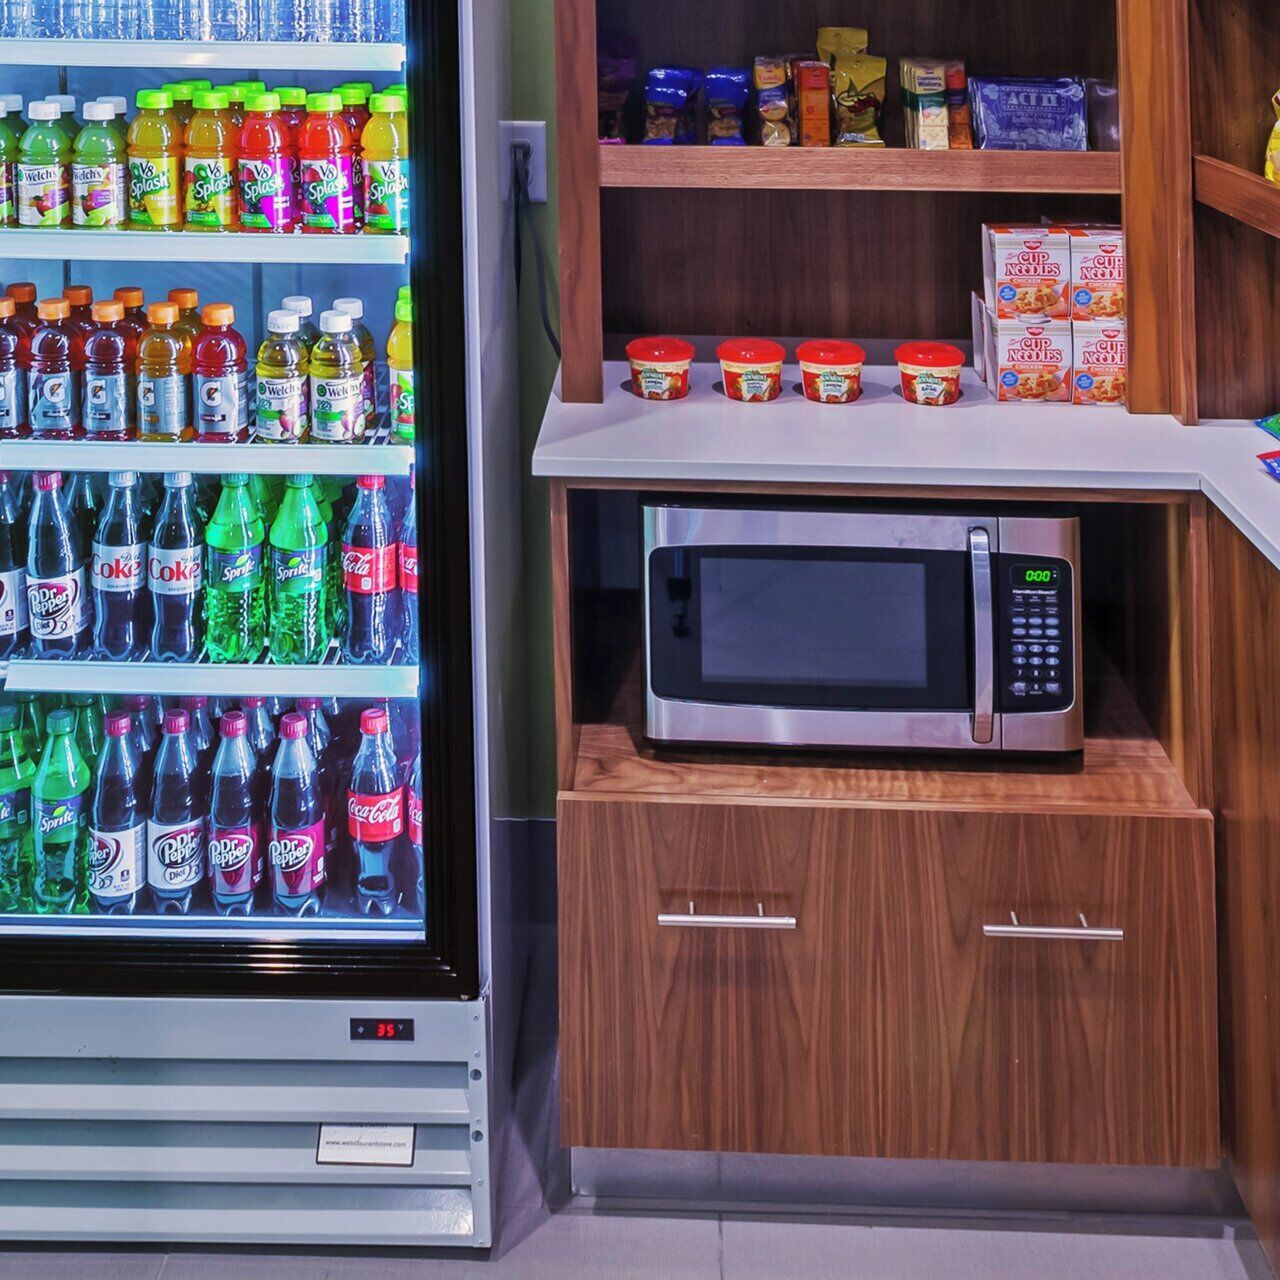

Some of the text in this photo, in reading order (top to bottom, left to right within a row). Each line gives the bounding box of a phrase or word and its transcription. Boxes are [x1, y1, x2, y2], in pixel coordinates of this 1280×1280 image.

[1006, 92, 1059, 107] ACT II
[24, 169, 58, 182] Welch's
[73, 168, 102, 181] Welch's
[138, 162, 154, 178] V8
[207, 162, 222, 180] V8
[254, 163, 270, 180] V8
[320, 163, 335, 180] V8
[381, 163, 396, 180] V8
[131, 173, 170, 197] Splash
[195, 172, 234, 200] Splash
[244, 173, 284, 202] Splash
[308, 176, 349, 203] Splash
[370, 174, 409, 203] Splash
[1018, 251, 1049, 266] CUP
[1005, 262, 1061, 277] NOODLES
[1021, 337, 1052, 351] CUP
[1007, 348, 1063, 363] NOODLES
[43, 378, 67, 403] G
[87, 379, 107, 405] G
[137, 381, 155, 406] G
[91, 553, 142, 580] Coke
[148, 557, 202, 583] Coke
[222, 559, 257, 582] Sprite
[276, 561, 309, 581] Sprite
[1025, 570, 1051, 582] 0:00
[30, 589, 70, 615] Pepper
[42, 586, 57, 602] Dr
[347, 796, 403, 825] Coca-Cola
[40, 809, 75, 833] Sprite
[179, 832, 194, 847] Dr
[222, 837, 239, 852] Dr
[282, 837, 298, 852] Dr
[163, 834, 202, 864] Pepper
[209, 840, 251, 866] Pepper
[270, 840, 312, 866] Pepper
[168, 868, 187, 880] Diet
[377, 1023, 394, 1037] 35
[324, 1139, 407, 1148] www.webstaurantstore.com
